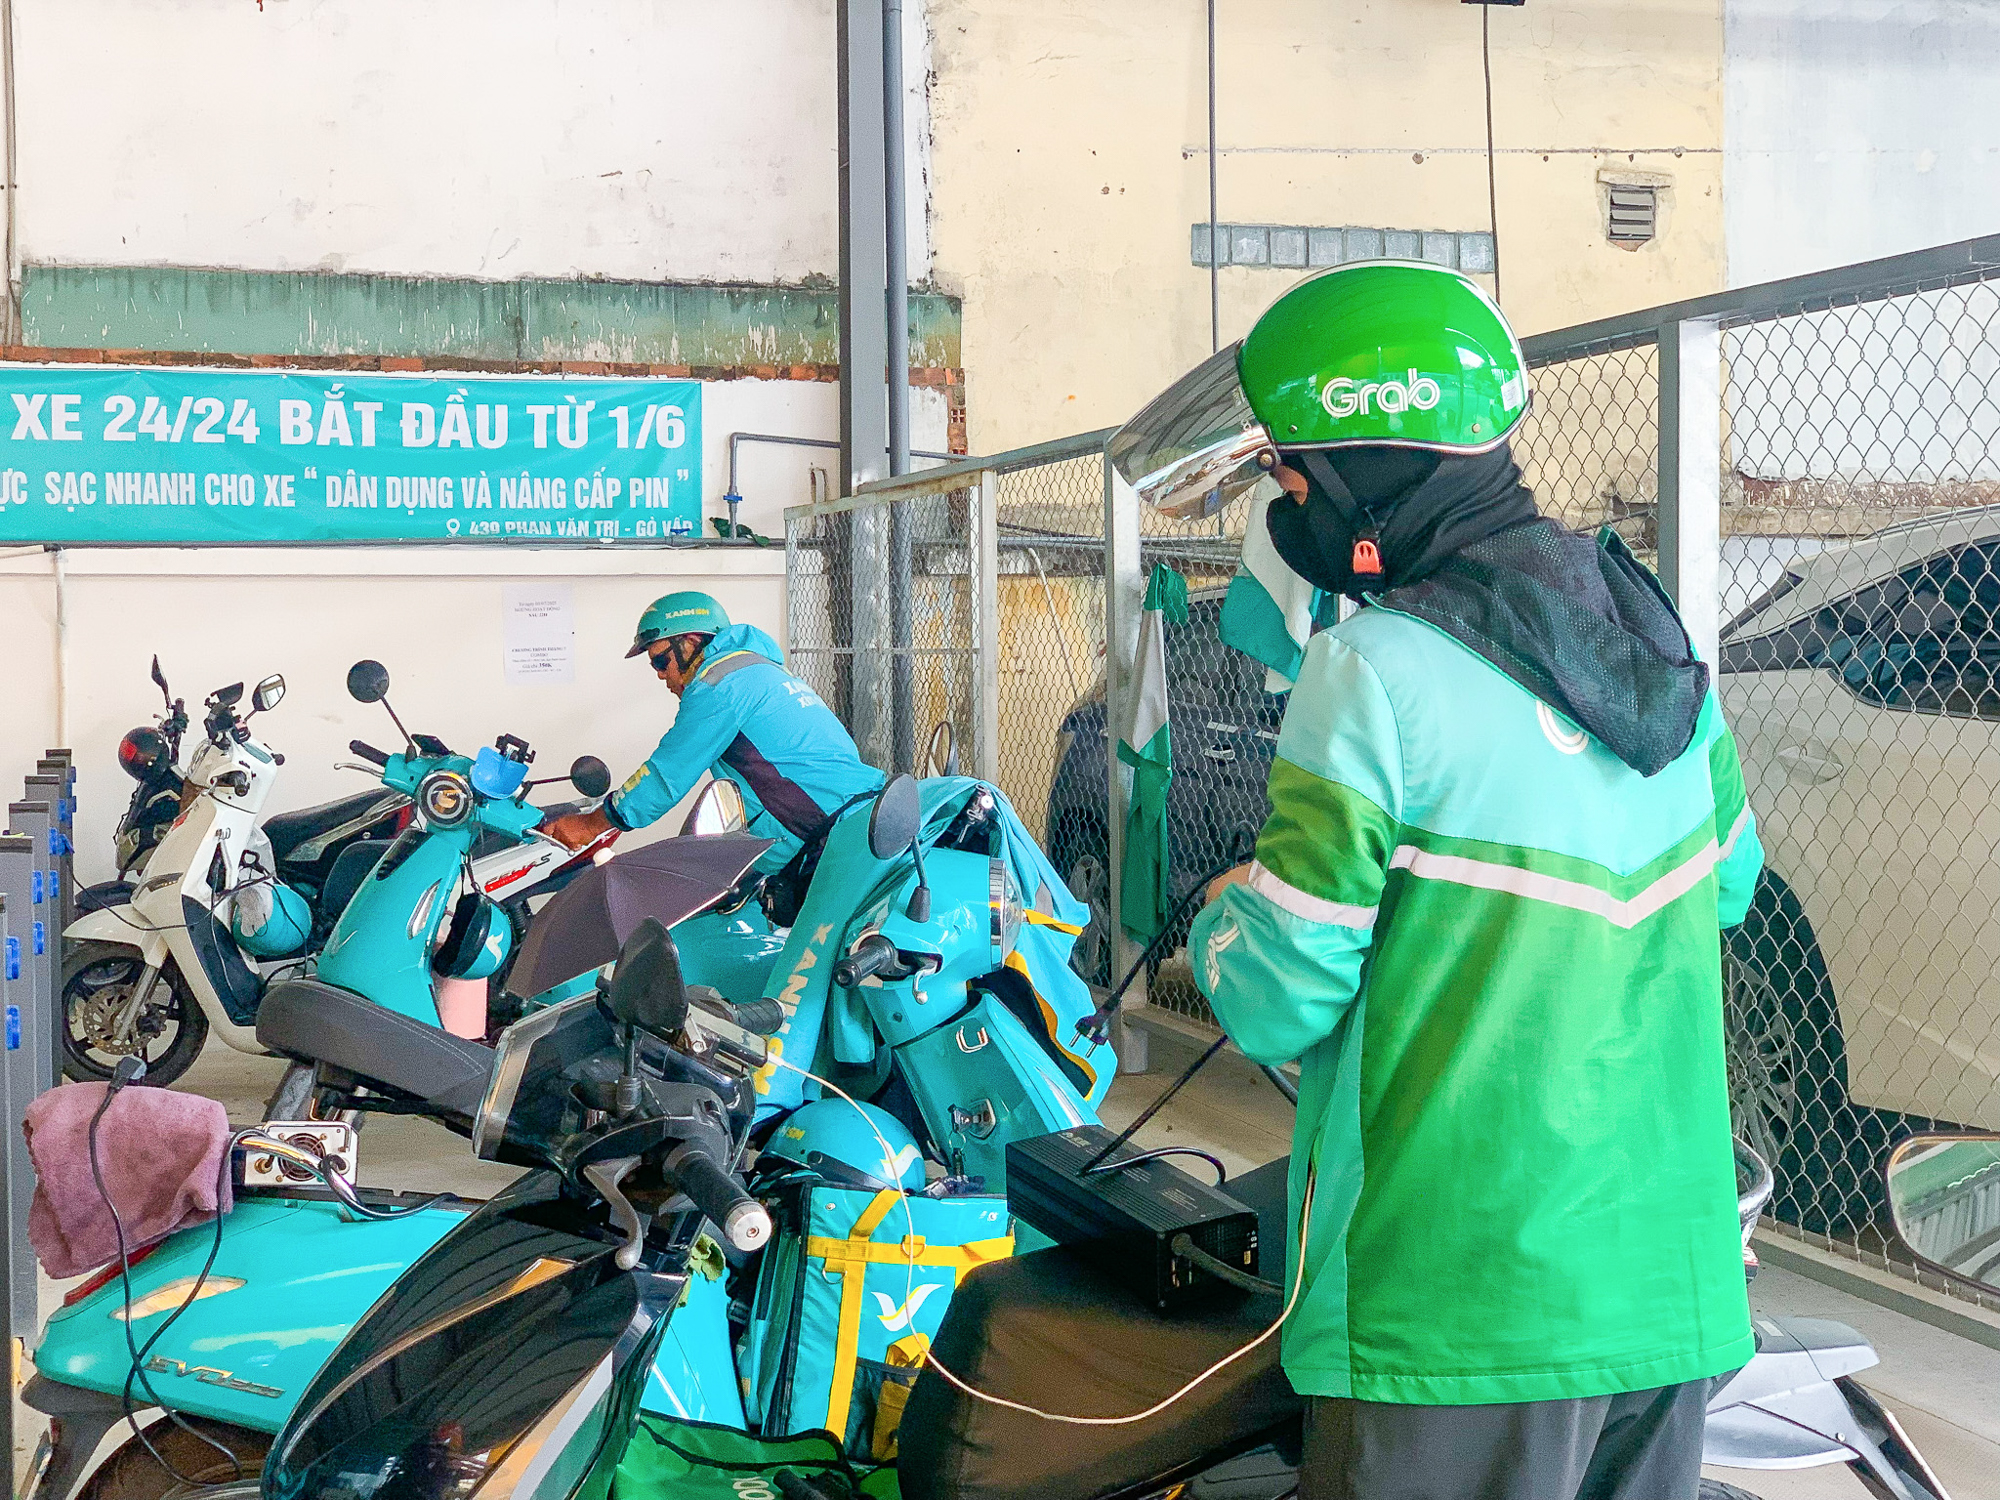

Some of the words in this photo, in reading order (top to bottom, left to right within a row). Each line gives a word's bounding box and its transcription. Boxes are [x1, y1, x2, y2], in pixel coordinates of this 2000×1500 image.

[10, 393, 83, 441] XE
[103, 395, 261, 444] 24/24
[279, 382, 384, 447] BẮT
[399, 387, 509, 450] ĐẦU
[526, 394, 596, 449] TỪ
[608, 404, 686, 450] 1/6
[1321, 368, 1440, 417] Grab
[44, 471, 97, 512] SẠC
[105, 471, 196, 506] NHANH
[204, 473, 256, 507] CHO
[263, 474, 296, 507] XE
[326, 468, 378, 509] DÂN
[385, 476, 454, 516] DỤNG
[460, 470, 493, 509] VÀ
[499, 470, 567, 510] NÂNG
[574, 466, 622, 510] CẤP
[629, 477, 670, 509] PIN
[469, 521, 500, 536] 439
[505, 520, 552, 536] PHAN
[556, 517, 590, 537] VĂN
[635, 516, 658, 538] GÒ
